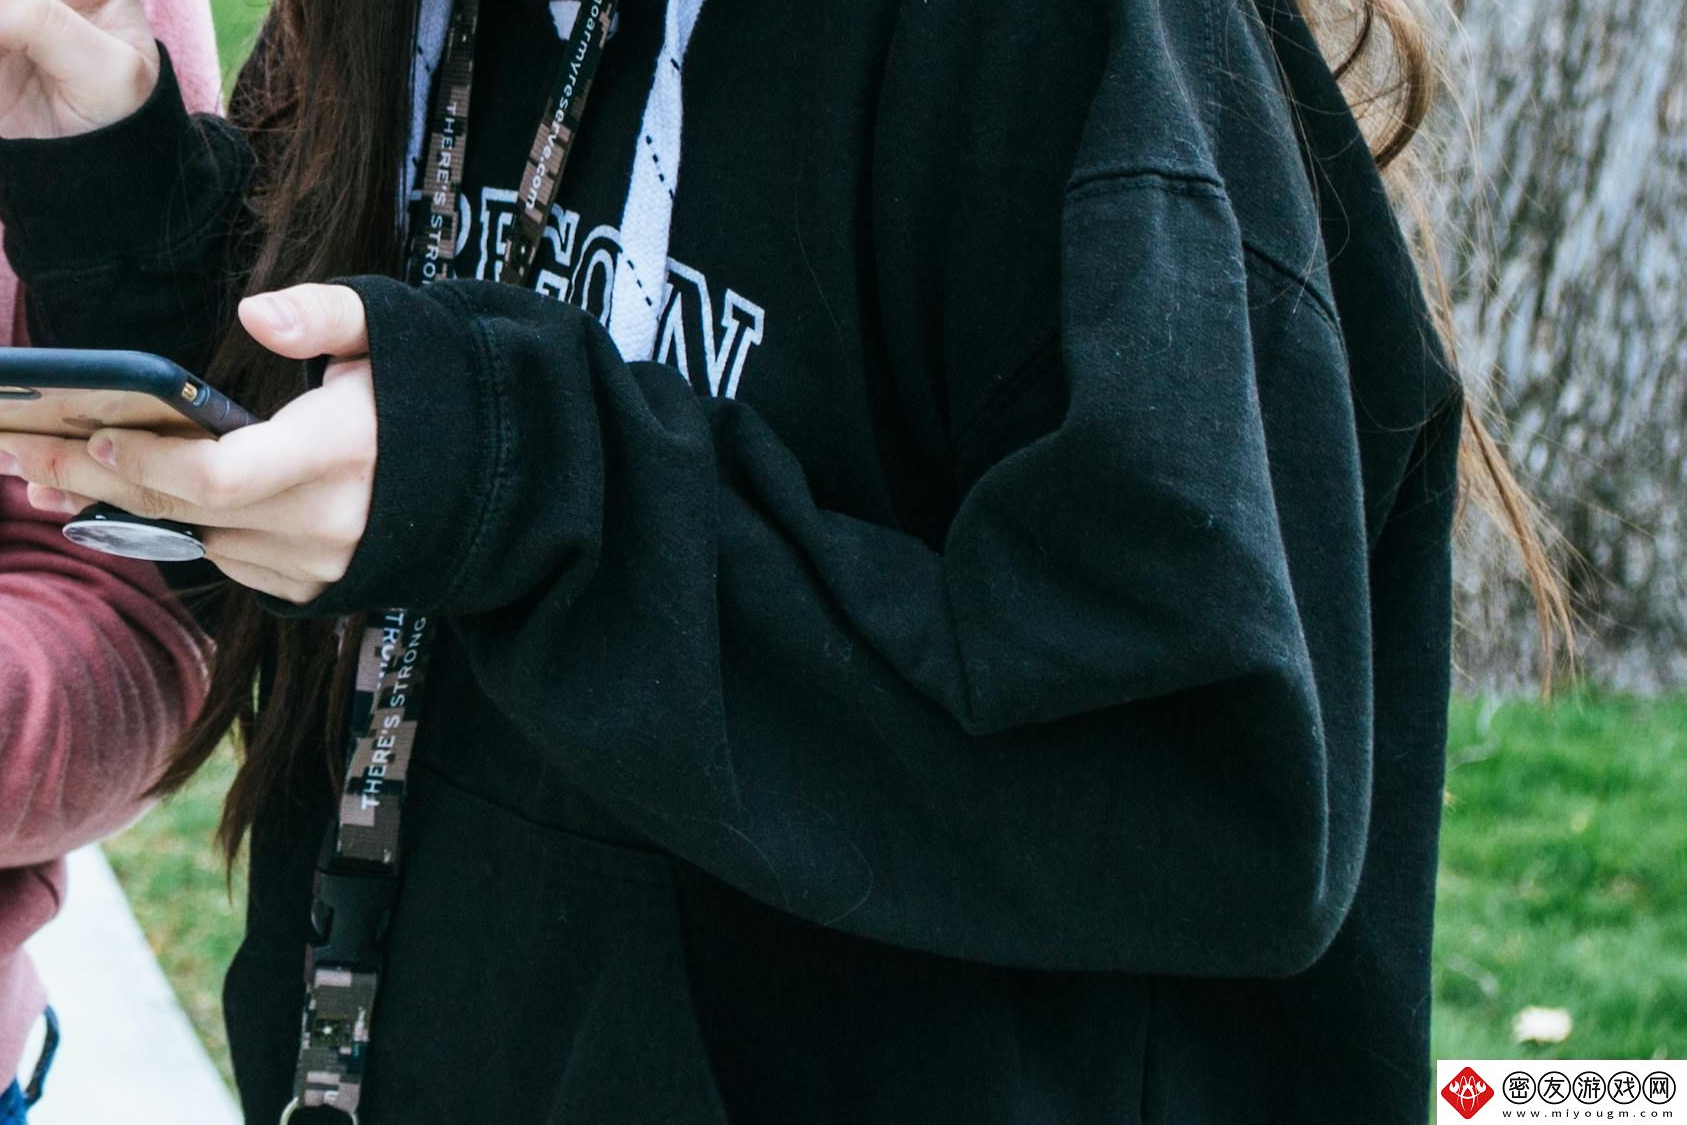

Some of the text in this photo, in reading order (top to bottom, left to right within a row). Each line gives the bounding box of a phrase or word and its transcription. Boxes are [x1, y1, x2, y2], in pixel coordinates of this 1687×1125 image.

[421, 101, 458, 285] THERE'S STRO
[360, 616, 427, 811] THERE'S STRONG
